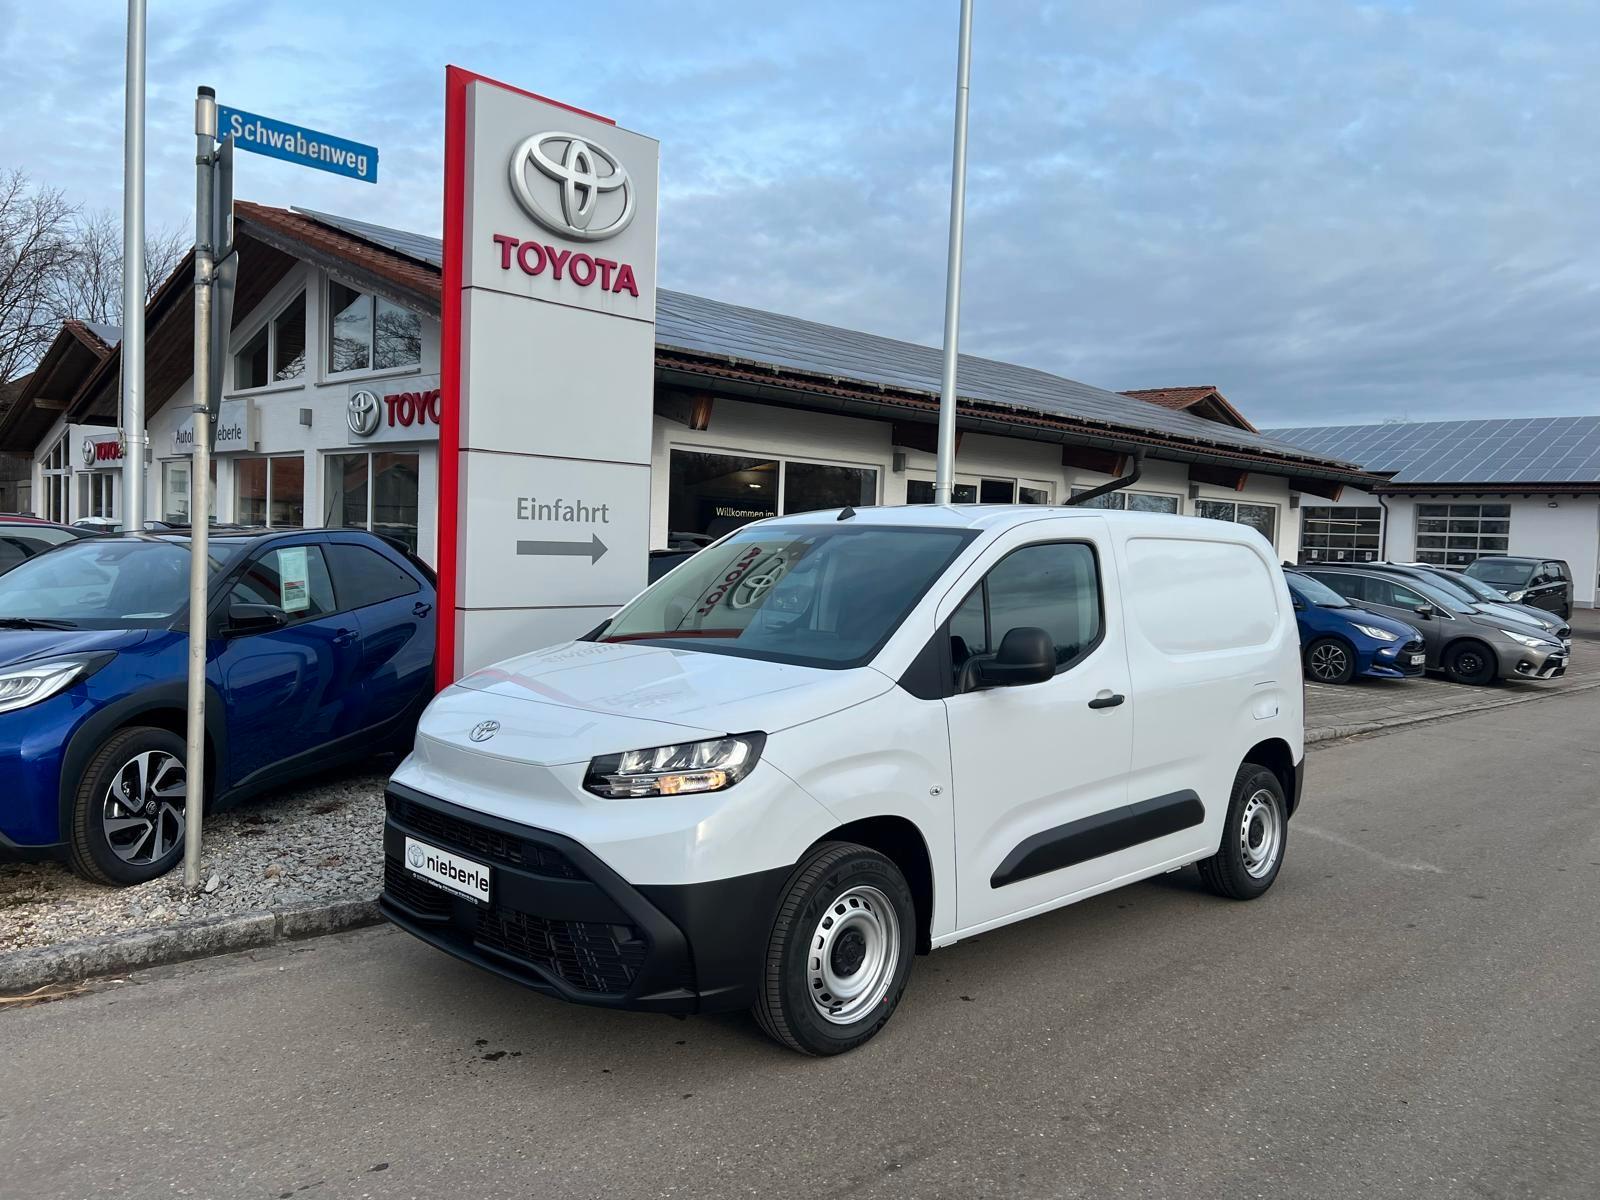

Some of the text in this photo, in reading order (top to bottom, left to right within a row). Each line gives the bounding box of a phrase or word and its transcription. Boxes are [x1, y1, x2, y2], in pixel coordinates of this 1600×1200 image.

[230, 114, 367, 176] Schwabenweg
[493, 233, 639, 297] TOYOTA
[384, 389, 441, 427] TOYO
[517, 497, 609, 523] Einfahrt
[716, 507, 764, 517] Willkommen
[427, 855, 489, 892] nieberle
